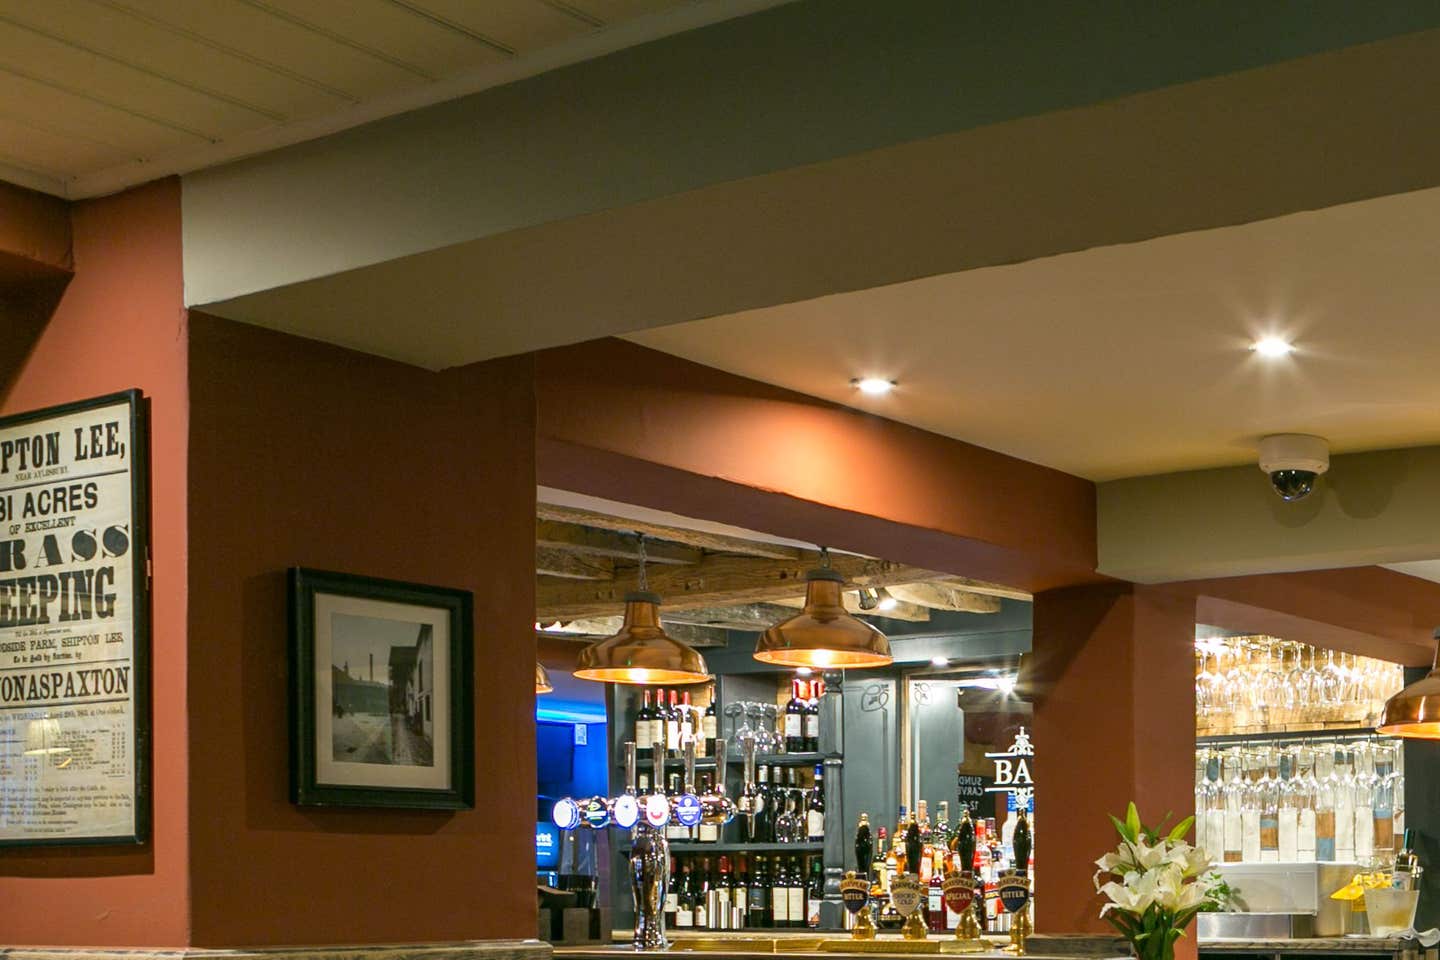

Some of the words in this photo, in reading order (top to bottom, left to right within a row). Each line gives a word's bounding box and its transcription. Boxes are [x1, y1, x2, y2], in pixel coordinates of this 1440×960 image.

[1, 432, 60, 474] PTON
[74, 421, 125, 461] LEE,
[22, 482, 98, 519] ACRES
